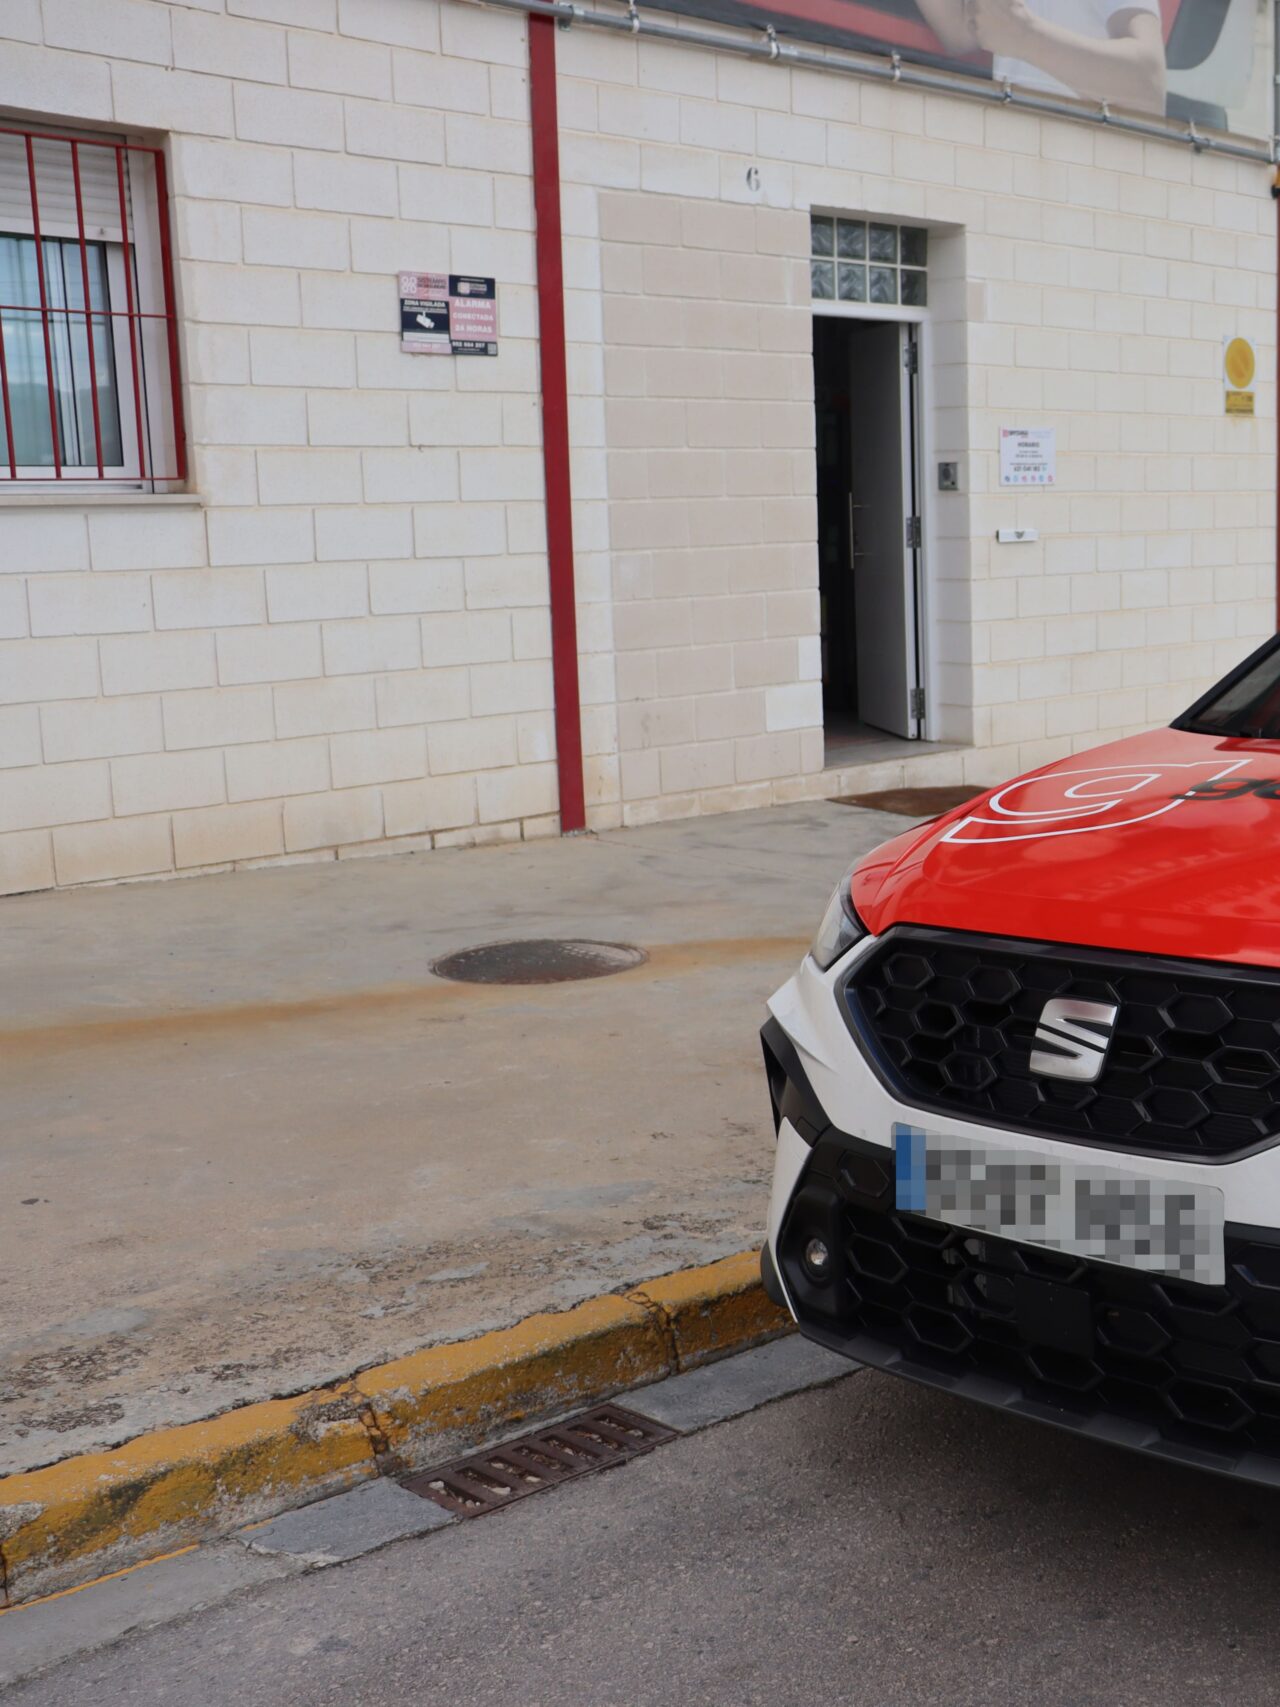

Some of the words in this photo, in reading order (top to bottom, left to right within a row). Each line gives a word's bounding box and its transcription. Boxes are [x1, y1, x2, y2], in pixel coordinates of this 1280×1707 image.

[746, 166, 761, 192] 6
[454, 299, 491, 309] ALARMA
[452, 312, 494, 322] CONECTADA
[466, 325, 492, 333] HORAS
